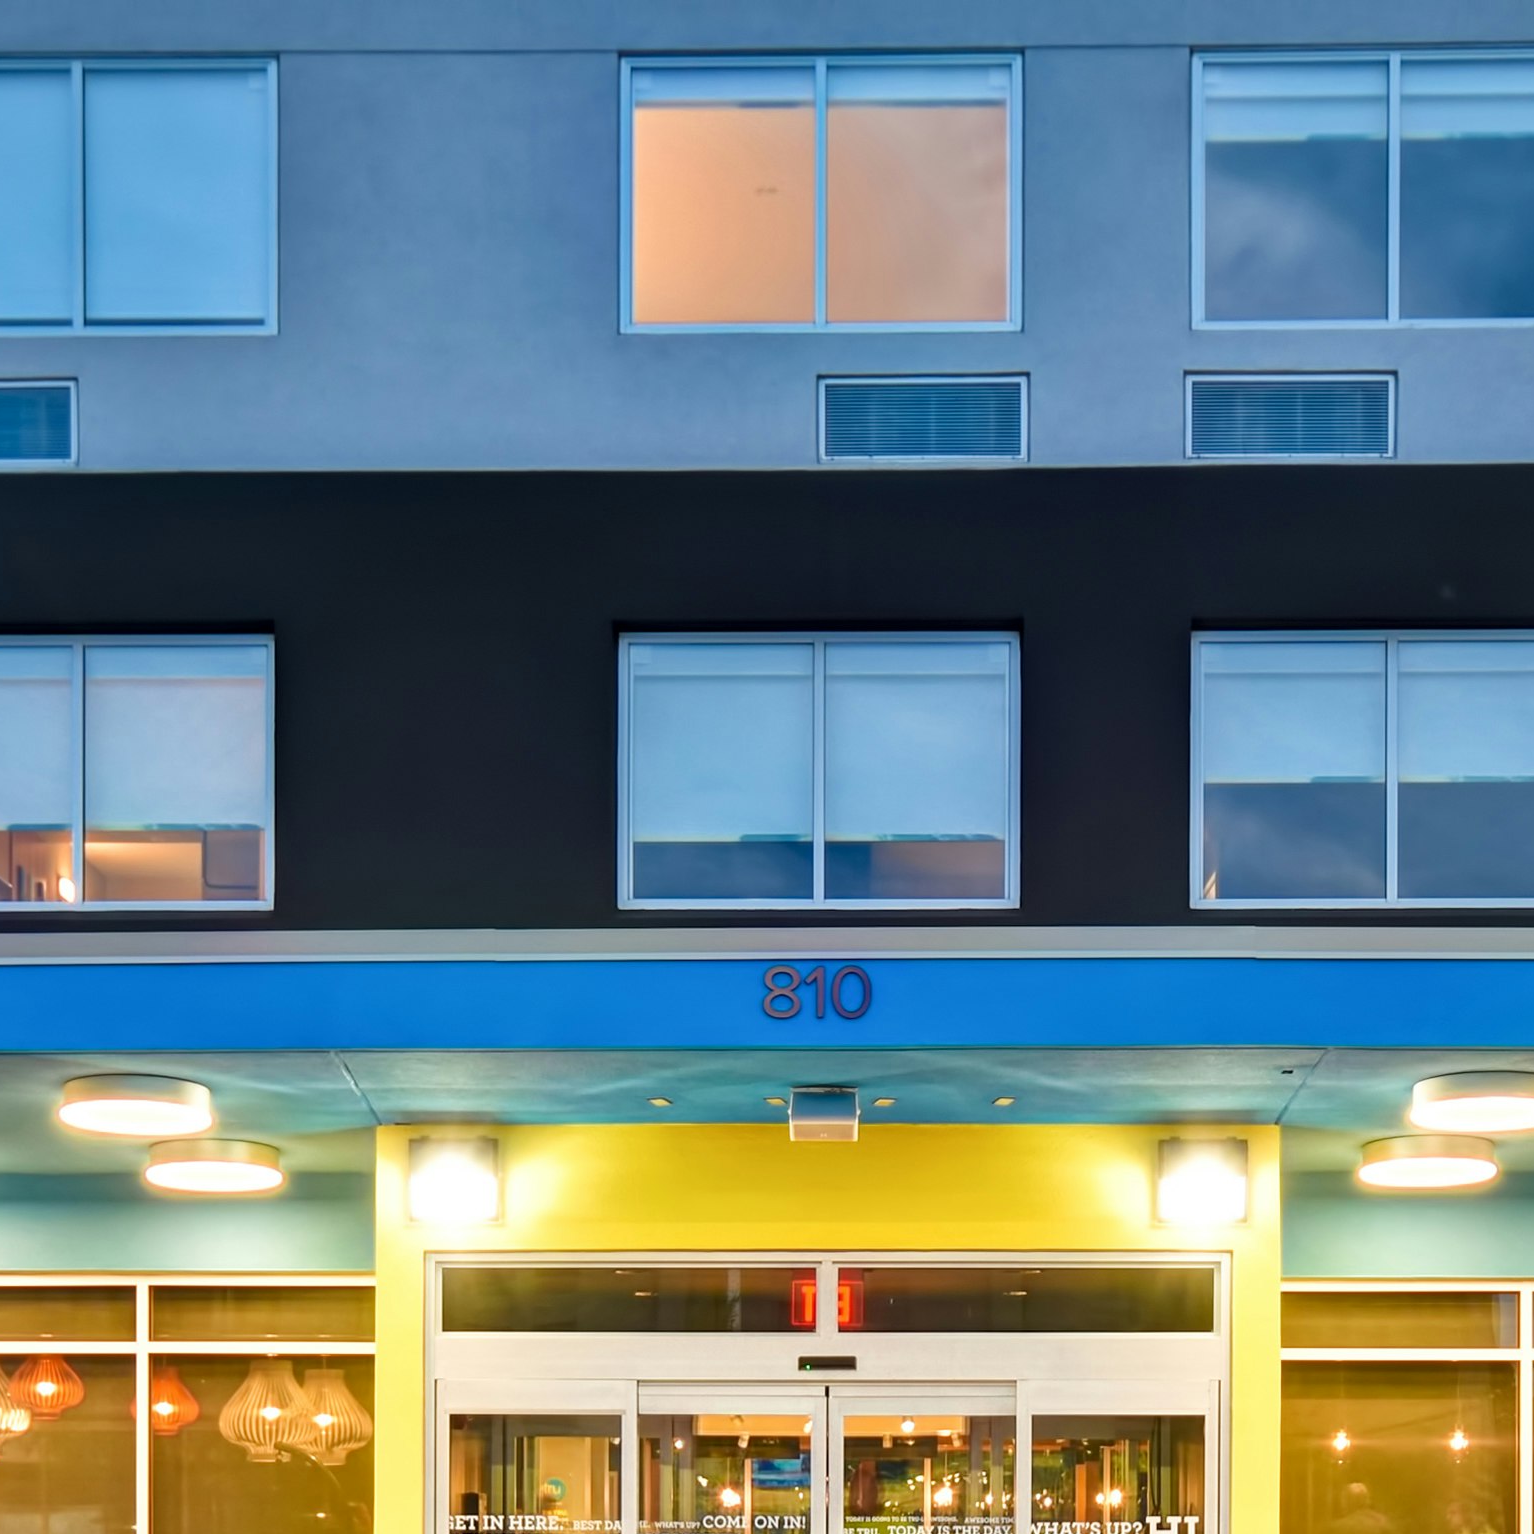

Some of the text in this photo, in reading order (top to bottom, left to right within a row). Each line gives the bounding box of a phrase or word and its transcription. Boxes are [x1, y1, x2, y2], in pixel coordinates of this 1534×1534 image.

[763, 965, 872, 1020] 810
[482, 1515, 504, 1530] IN
[509, 1515, 564, 1531] HERE.
[573, 1520, 602, 1530] BEST
[686, 1521, 700, 1529] UP?
[754, 1516, 806, 1529] ON IN!
